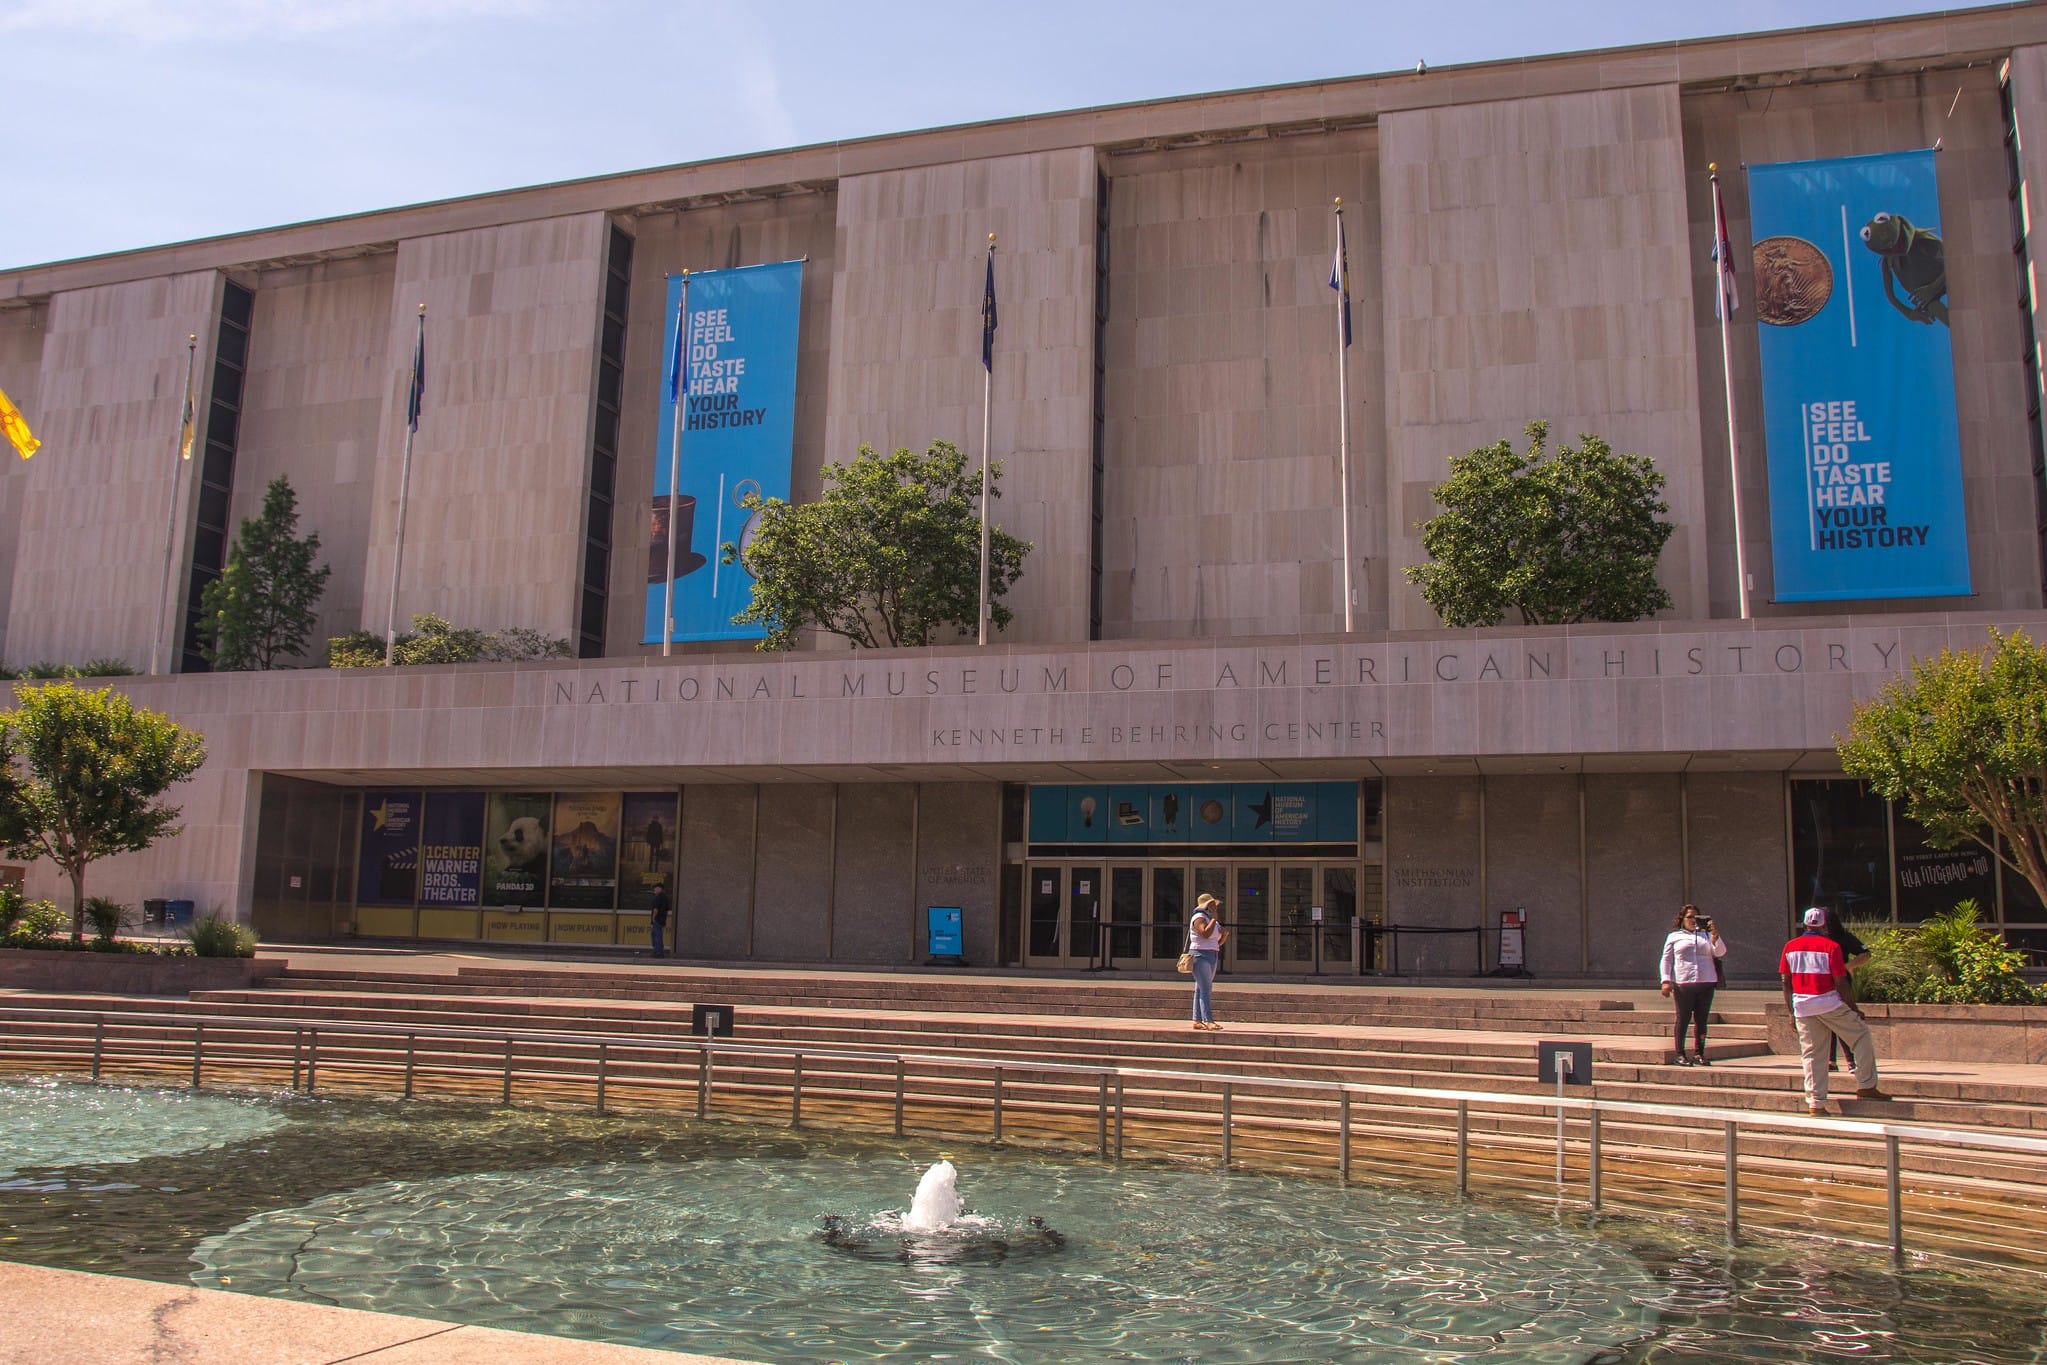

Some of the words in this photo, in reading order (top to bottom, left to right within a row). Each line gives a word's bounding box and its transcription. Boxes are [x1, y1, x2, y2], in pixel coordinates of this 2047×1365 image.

[694, 309, 728, 327] SEE
[693, 325, 735, 344] FEEL
[692, 344, 718, 361] DO
[690, 358, 746, 378] TASTE
[689, 376, 738, 396] HEAR
[688, 394, 739, 413] YOUR
[1810, 400, 1857, 422] SEE
[687, 408, 767, 431] HISTORY
[1811, 421, 1872, 444] FEEL
[1813, 443, 1849, 465] DO
[1813, 461, 1892, 486] TASTE
[1815, 484, 1885, 508] HEAR
[1816, 506, 1887, 529] YOUR
[1818, 525, 1930, 550] HISTORY
[555, 675, 806, 705] NATIONAL
[841, 667, 1069, 698] MUSEUM
[1111, 664, 1173, 690] OF
[1216, 653, 1551, 687] AMERICAN
[1603, 642, 1897, 677] HISTORY
[932, 727, 1064, 746] KENNETH
[1111, 724, 1247, 745] BEHRING
[1264, 721, 1387, 741] CENTER
[425, 860, 478, 874] WARNER
[1394, 868, 1474, 878] SMITHSONIAN
[1900, 868, 1921, 888] ELLA
[1920, 863, 1968, 884] FITZGERALD
[1973, 856, 1988, 876] 100
[424, 873, 461, 887] BROS.
[496, 882, 524, 891] PANDAS
[525, 882, 535, 891] 3D
[1397, 878, 1471, 887] INSTITUTION
[423, 887, 477, 901] THEATER
[491, 921, 508, 929] NOW
[510, 922, 541, 931] PLAYING
[577, 924, 609, 932] PLAYING
[626, 925, 645, 933] NOW
